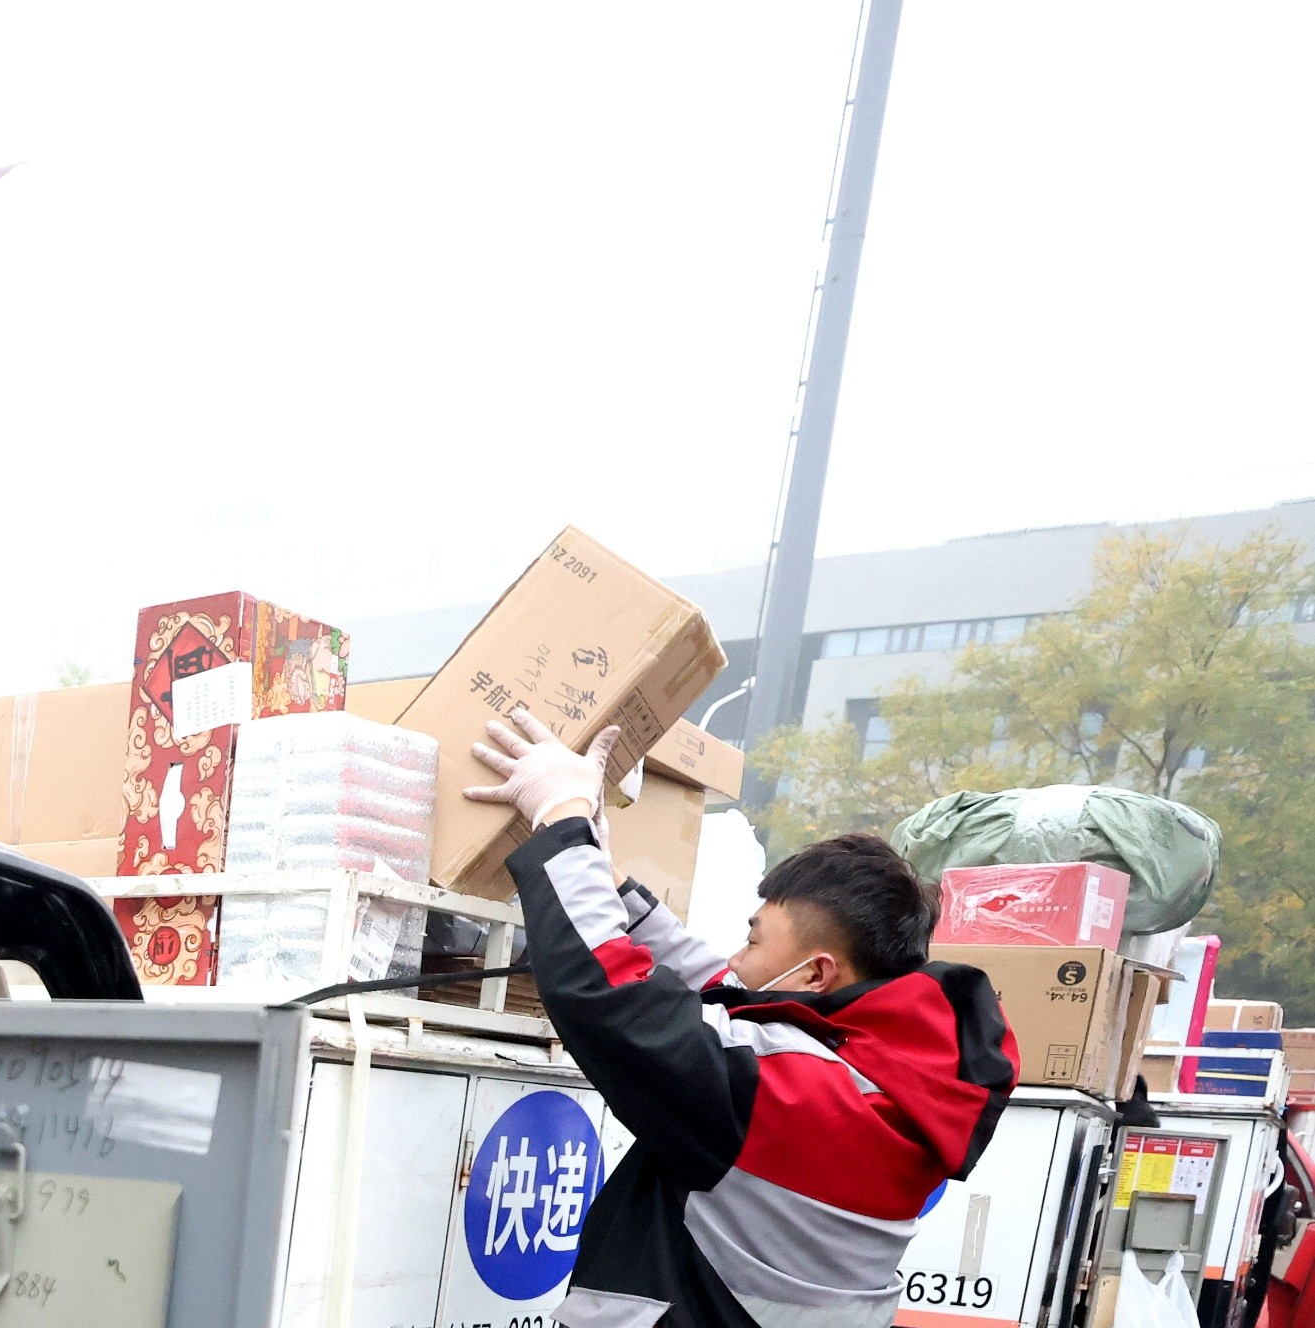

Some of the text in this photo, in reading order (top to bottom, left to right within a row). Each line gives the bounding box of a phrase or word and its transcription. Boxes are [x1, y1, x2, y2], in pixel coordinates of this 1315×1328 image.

[563, 556, 597, 583] 2091
[483, 1135, 588, 1256] 快递
[896, 1269, 993, 1309] 6319
